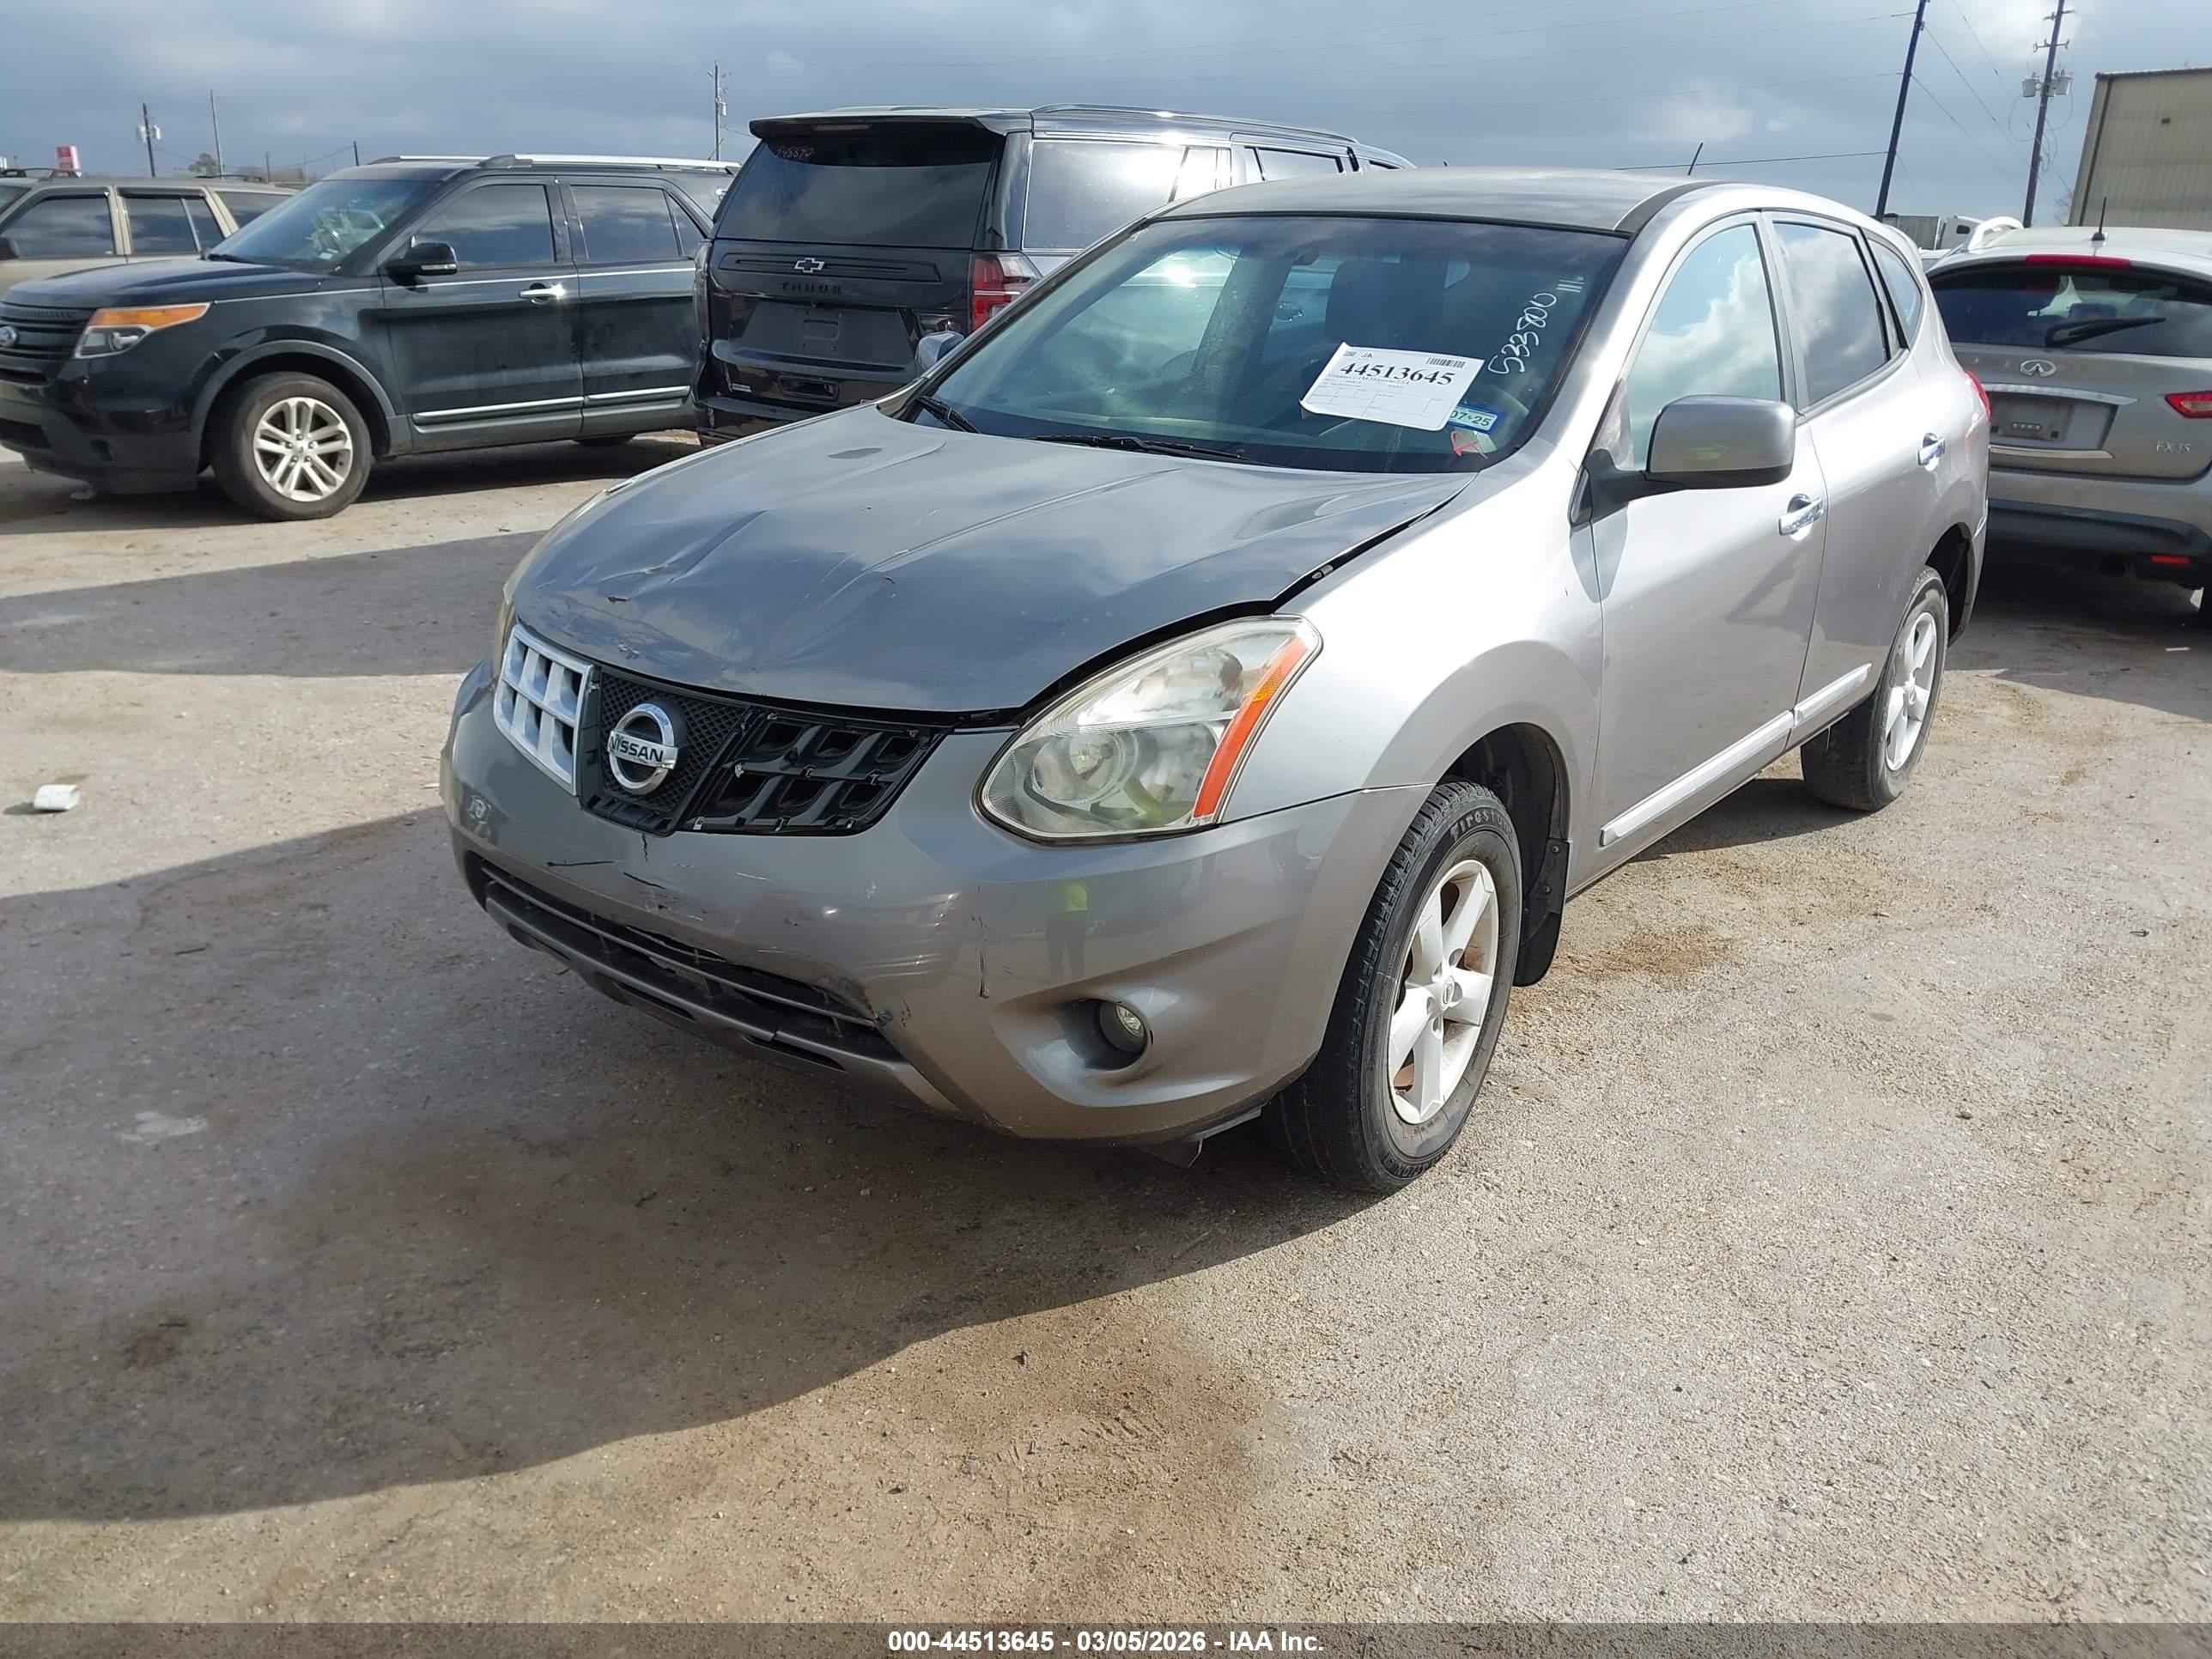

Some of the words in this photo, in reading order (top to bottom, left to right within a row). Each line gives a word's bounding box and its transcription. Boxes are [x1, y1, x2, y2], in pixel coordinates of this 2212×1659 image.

[1487, 292, 1557, 374] 533800
[1340, 362, 1456, 386] 44513645
[1472, 416, 1492, 427] 25
[609, 734, 665, 763] NISSAN
